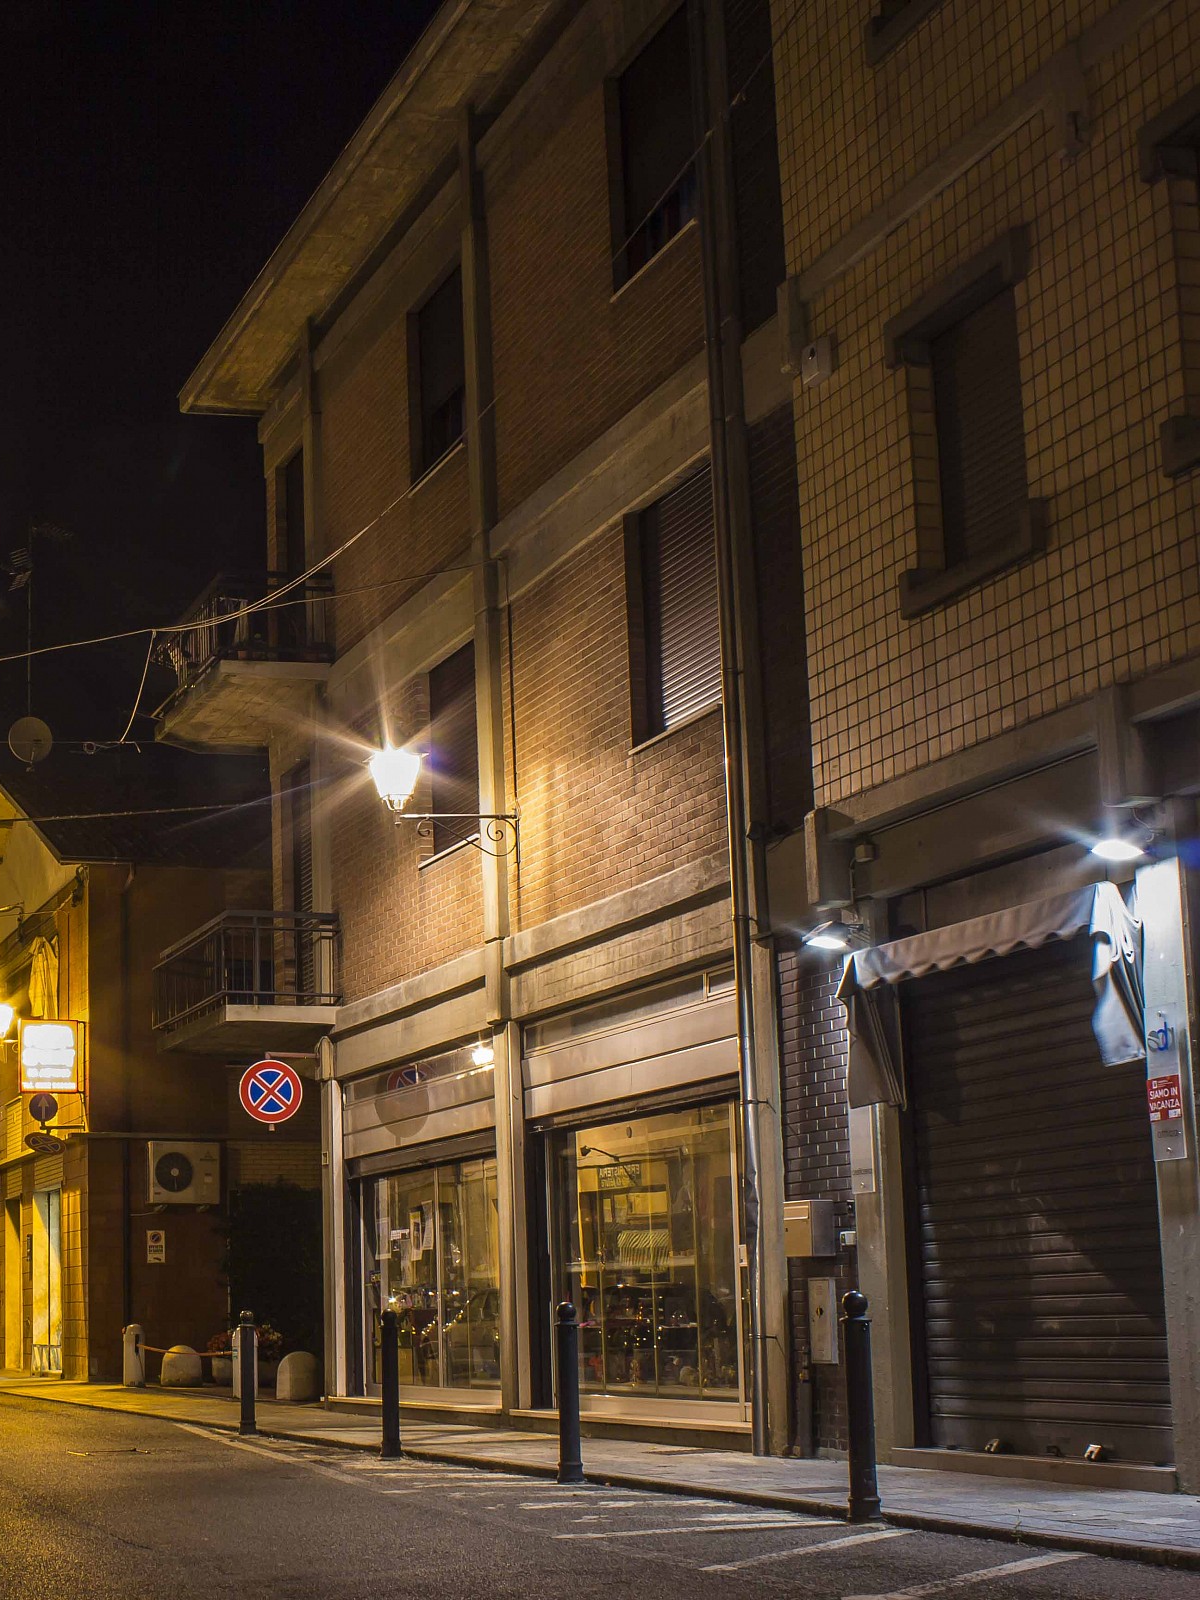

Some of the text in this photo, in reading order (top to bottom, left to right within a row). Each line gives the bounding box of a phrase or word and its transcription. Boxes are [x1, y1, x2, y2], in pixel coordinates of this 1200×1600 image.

[1149, 1086, 1178, 1100] SIAMO IN
[1149, 1098, 1180, 1111] VACANZA
